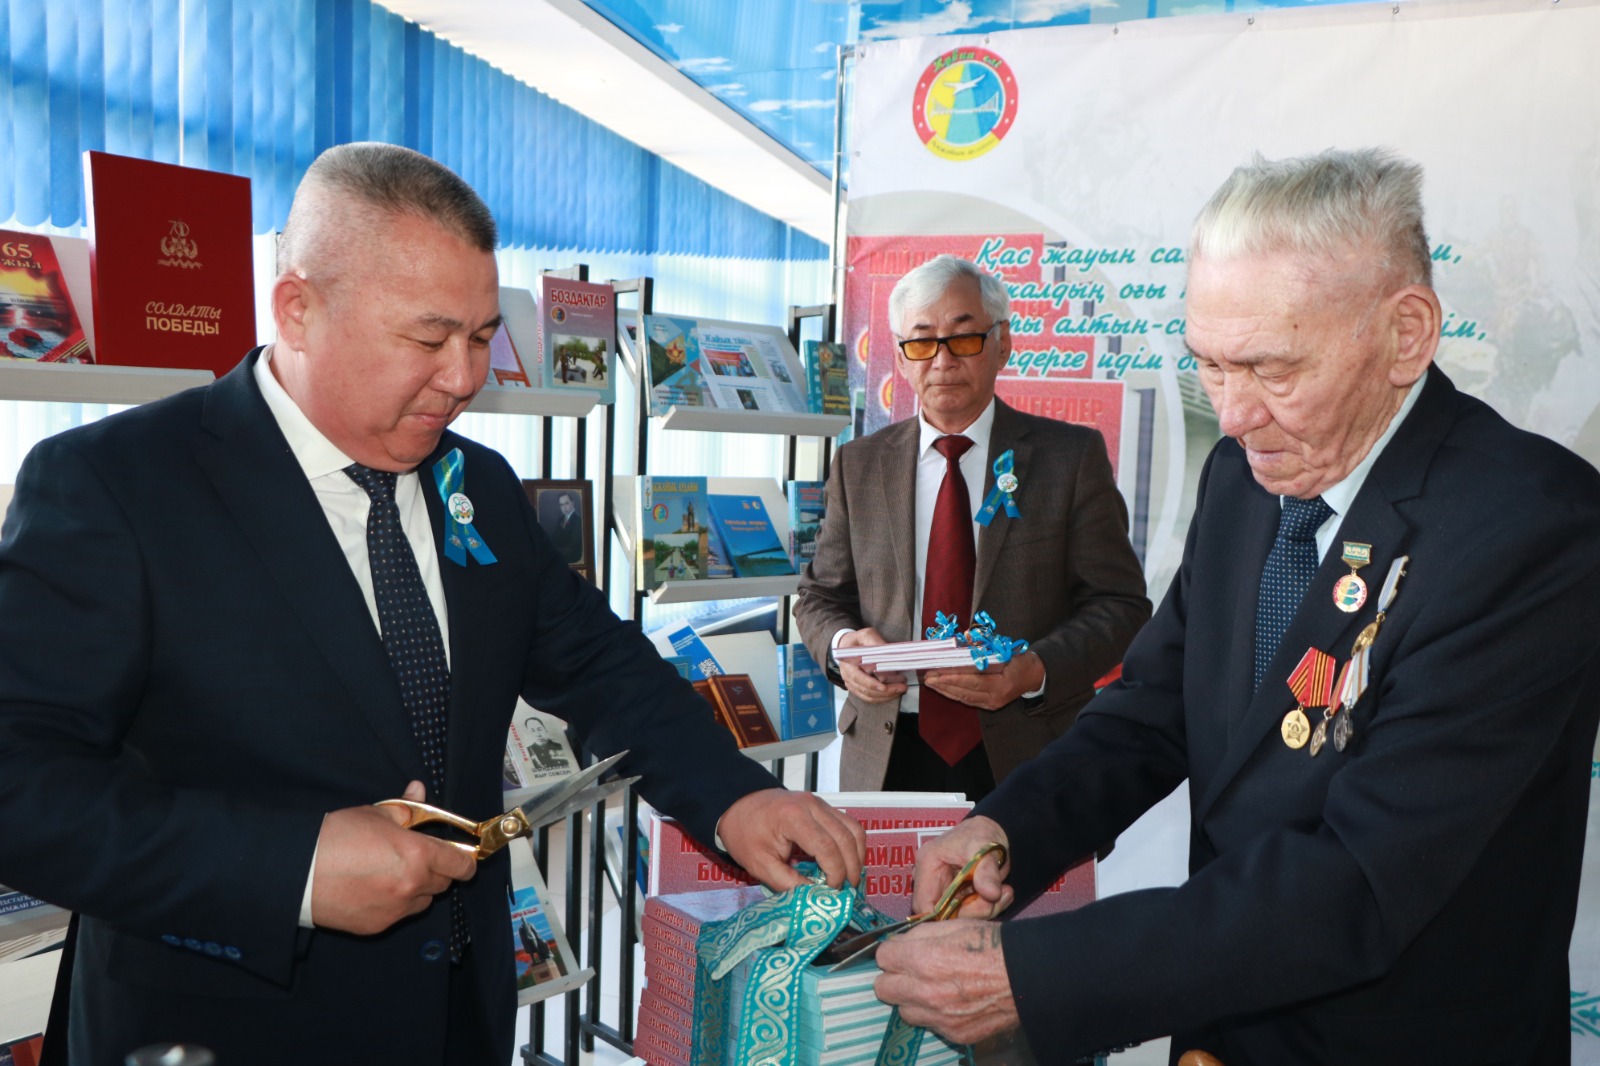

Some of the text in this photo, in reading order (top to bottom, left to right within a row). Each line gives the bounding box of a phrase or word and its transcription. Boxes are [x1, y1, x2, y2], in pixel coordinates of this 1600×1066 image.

[2, 242, 33, 259] 65
[976, 239, 1032, 271] Қас
[1041, 247, 1136, 272] жауын
[1150, 247, 1185, 264] са
[551, 289, 607, 308] БОЗДАҚТАР
[1119, 282, 1166, 300] оғы
[145, 301, 222, 320] СОЛДАТЫ
[146, 316, 220, 336] ПОБЕДЫ
[865, 843, 918, 868] АЙДА
